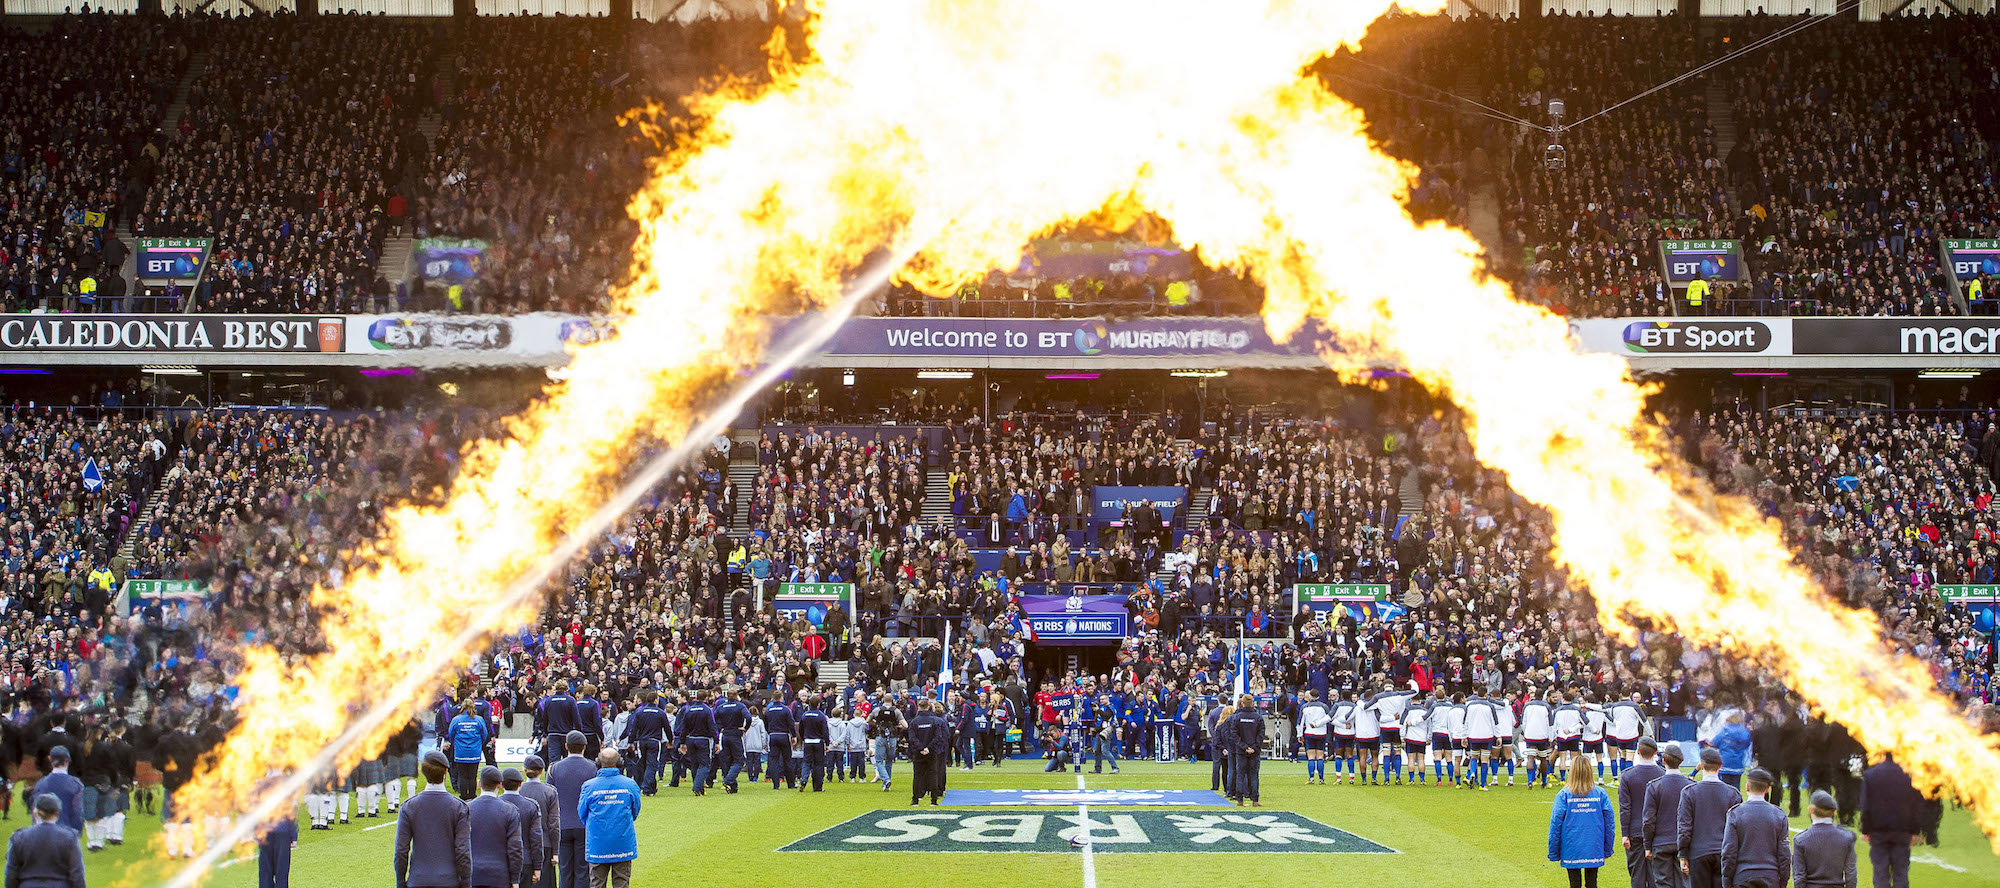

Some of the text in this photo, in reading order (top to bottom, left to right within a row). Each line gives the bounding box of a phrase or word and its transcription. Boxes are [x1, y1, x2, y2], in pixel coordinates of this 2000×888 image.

[1667, 242, 1678, 250] 28
[1722, 241, 1732, 249] 28
[1948, 241, 1959, 249] 30
[148, 260, 175, 272] BT
[1673, 262, 1700, 275] BT
[1955, 261, 1982, 274] BT
[1, 320, 312, 349] CALEDONIA BEST
[886, 328, 1249, 348] Welcome to BT MURRAYFIELD
[1641, 326, 1755, 350] BT Sport
[832, 586, 844, 594] 17
[1304, 587, 1316, 595] 19
[1368, 587, 1380, 595] 19
[1942, 588, 1955, 596] 23
[1044, 621, 1112, 631] RBS NATIONS
[841, 814, 1151, 843] RBS
